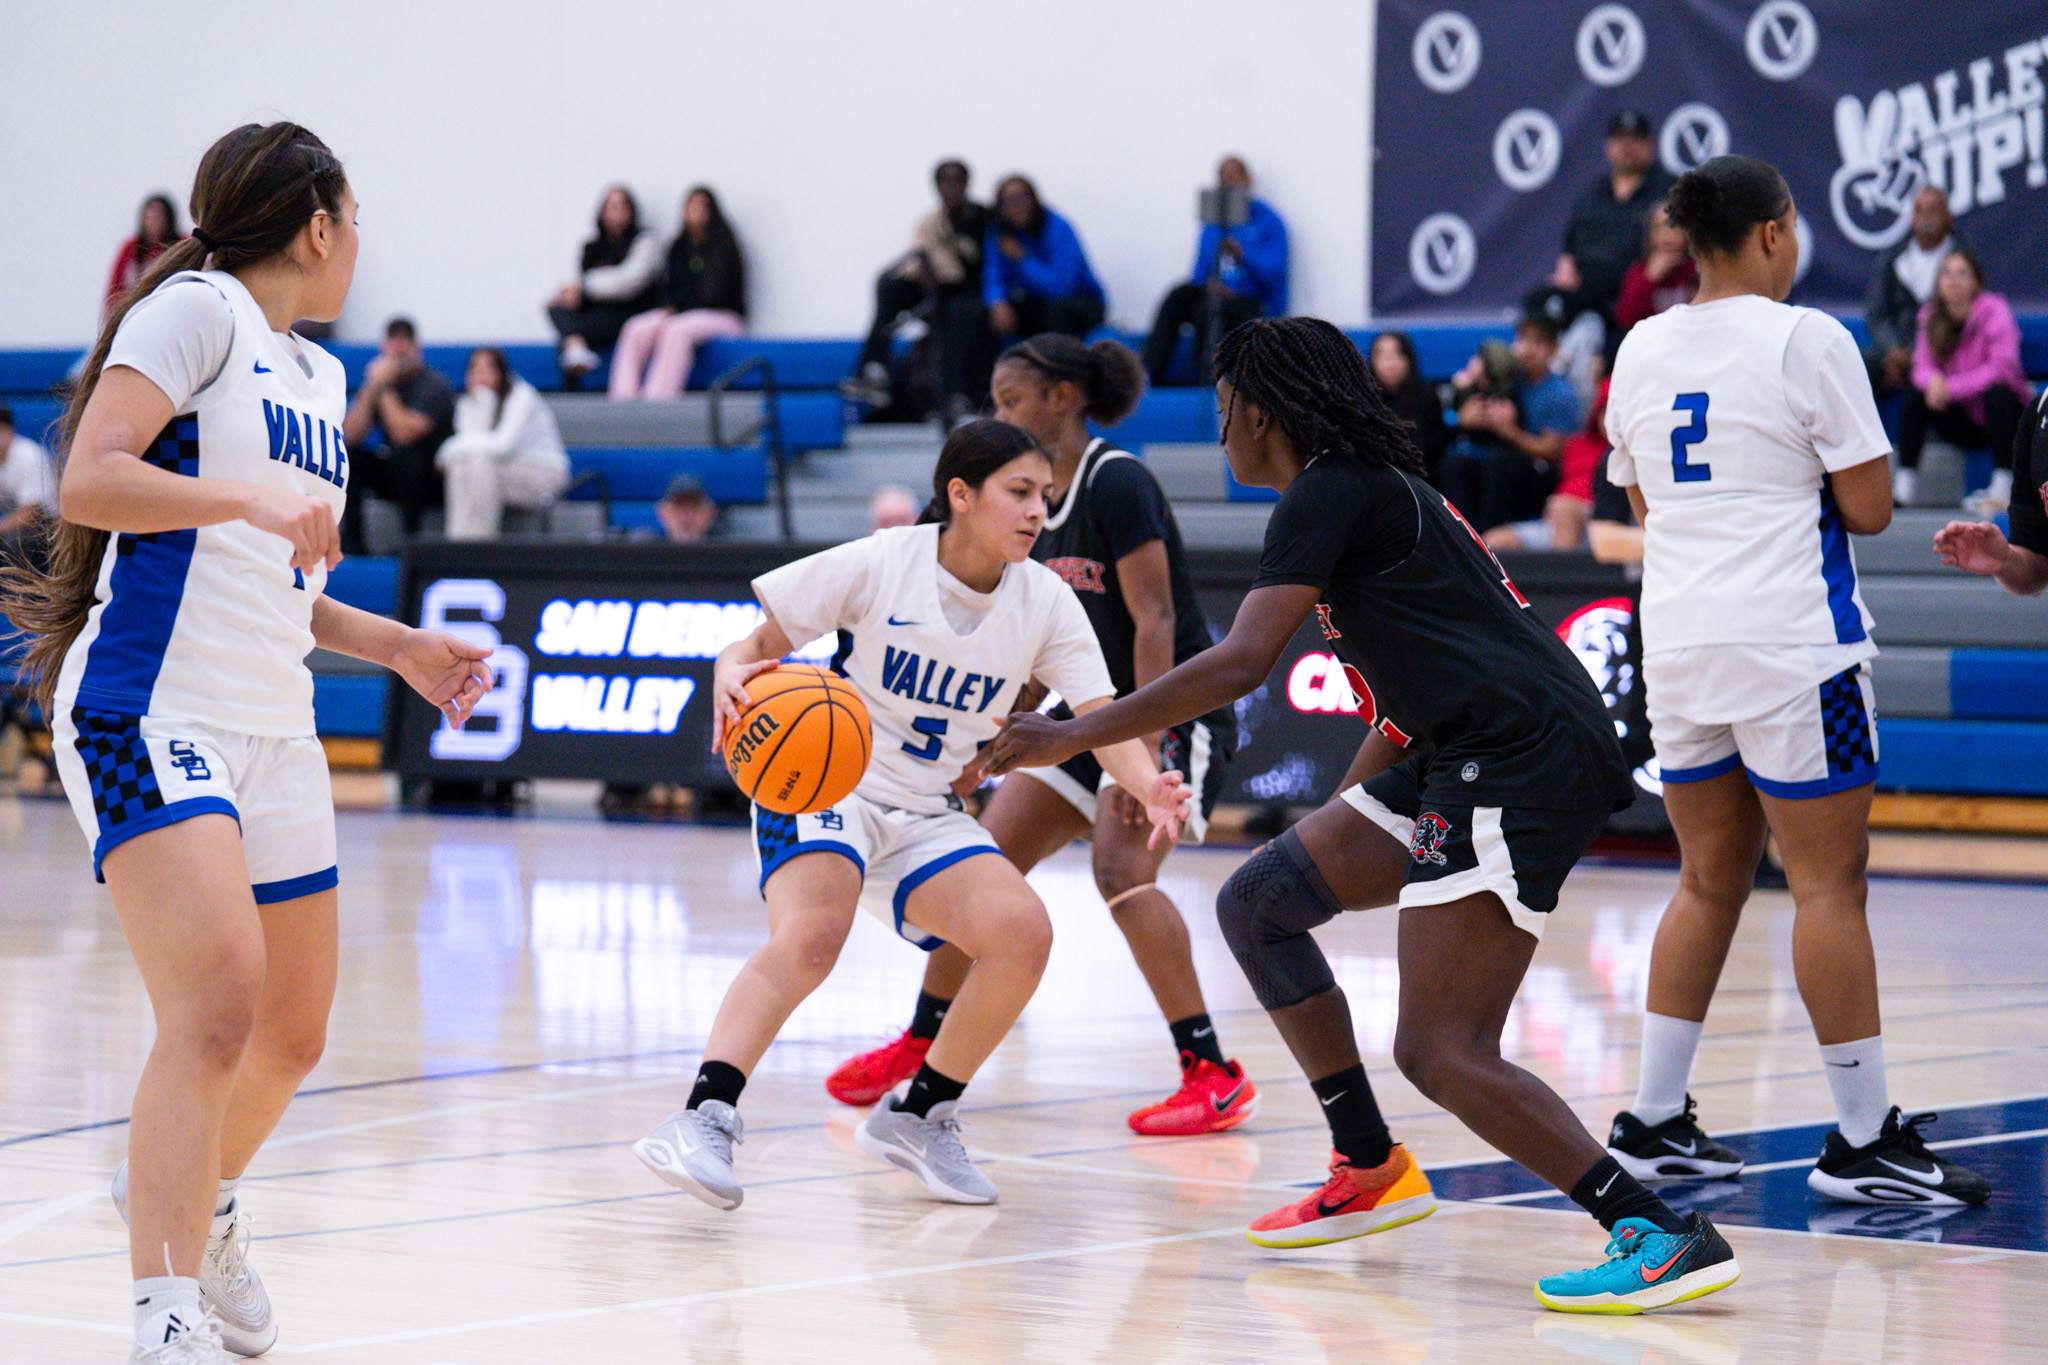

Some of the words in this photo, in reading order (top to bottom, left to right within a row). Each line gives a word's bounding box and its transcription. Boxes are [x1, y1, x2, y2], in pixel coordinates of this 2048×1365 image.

[1834, 36, 2048, 166] VALLE
[1922, 108, 2046, 217] UP!
[262, 398, 347, 490] VALLE
[1671, 392, 1711, 482] 2
[534, 599, 634, 658] SAN
[532, 674, 695, 734] VALLEY
[882, 645, 1006, 714] VALLEY
[727, 711, 781, 785] Wilso
[901, 716, 948, 761] 5
